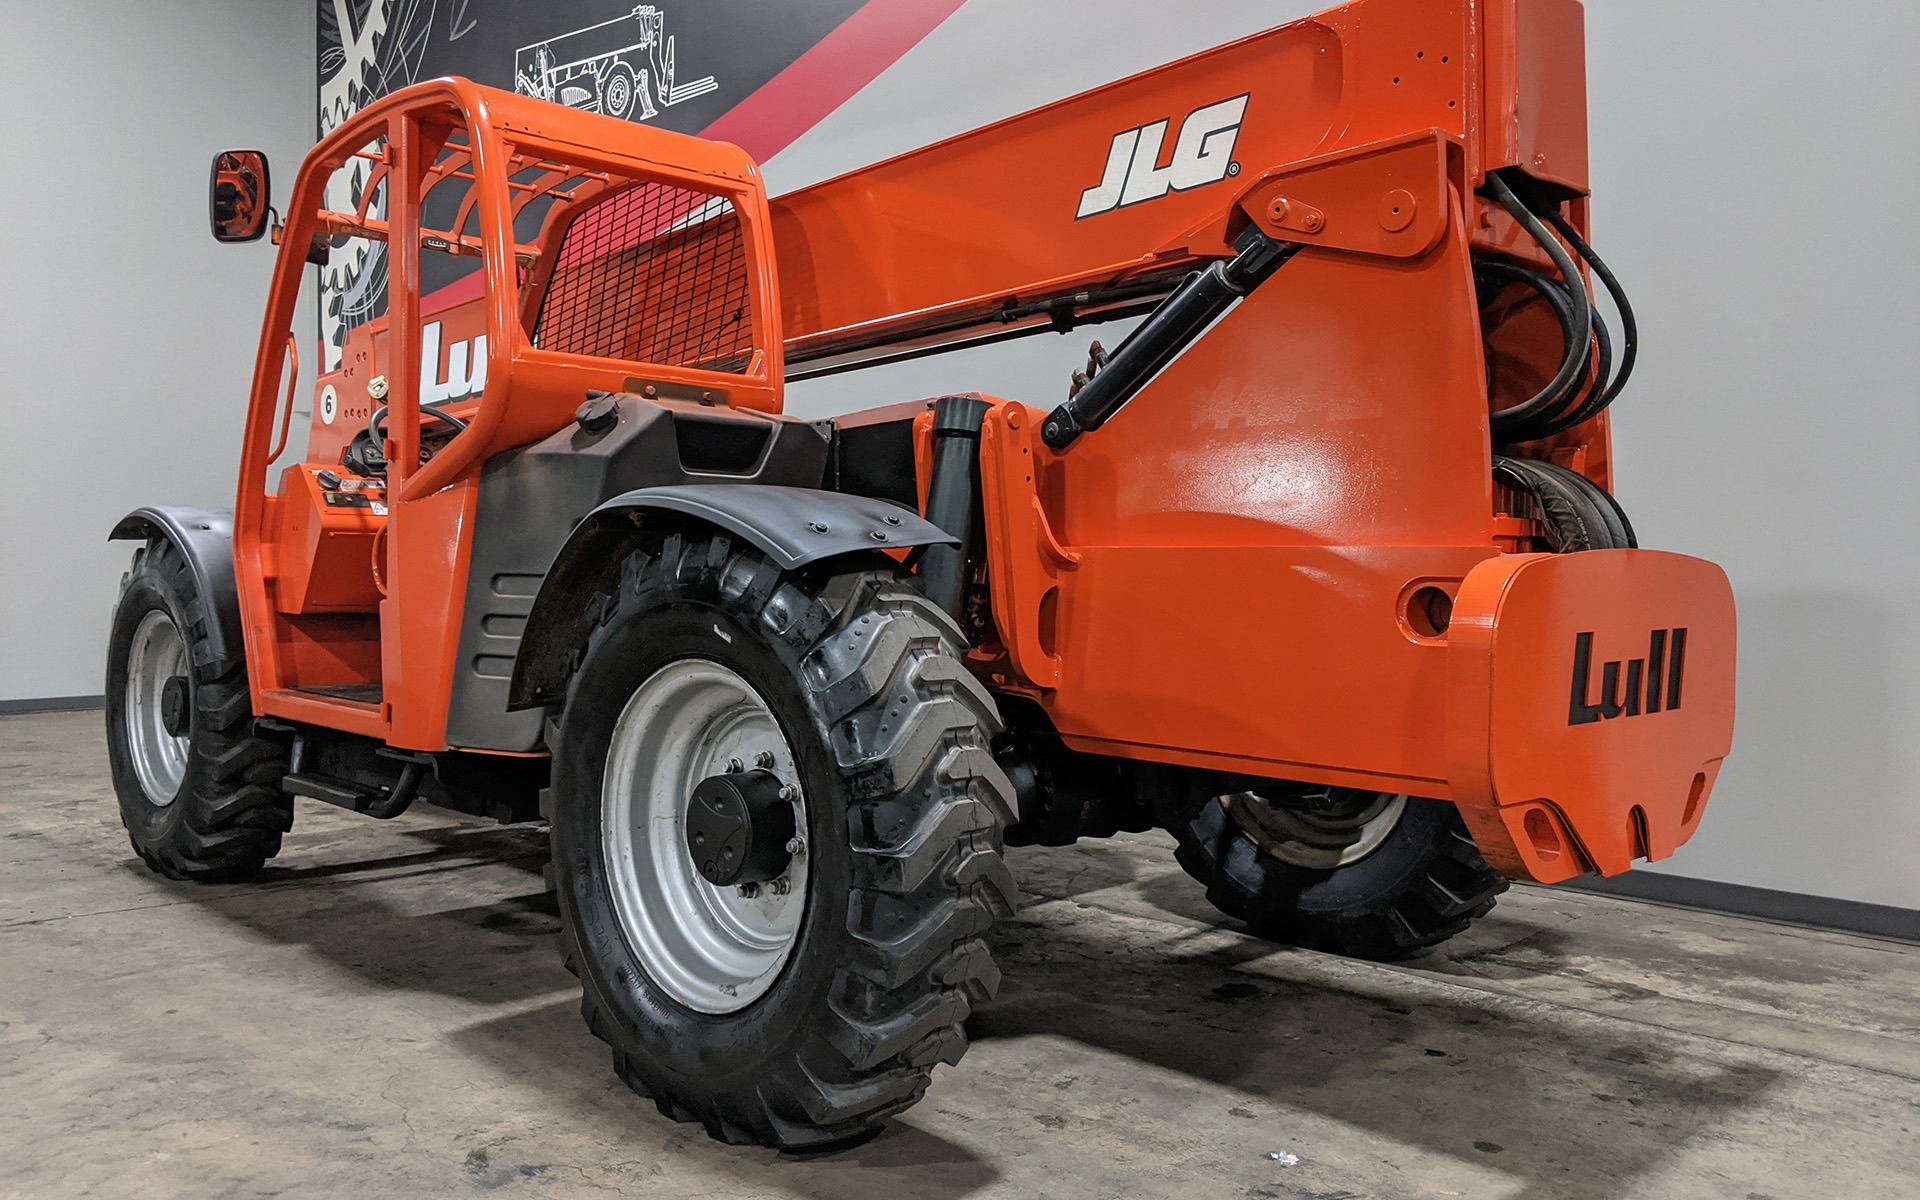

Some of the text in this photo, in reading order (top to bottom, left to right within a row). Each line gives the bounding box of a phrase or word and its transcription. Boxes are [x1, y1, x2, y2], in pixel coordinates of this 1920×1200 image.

[1074, 92, 1251, 221] JLG
[325, 394, 332, 415] 6
[419, 320, 488, 406] Lu
[1568, 627, 1688, 726] Lull
